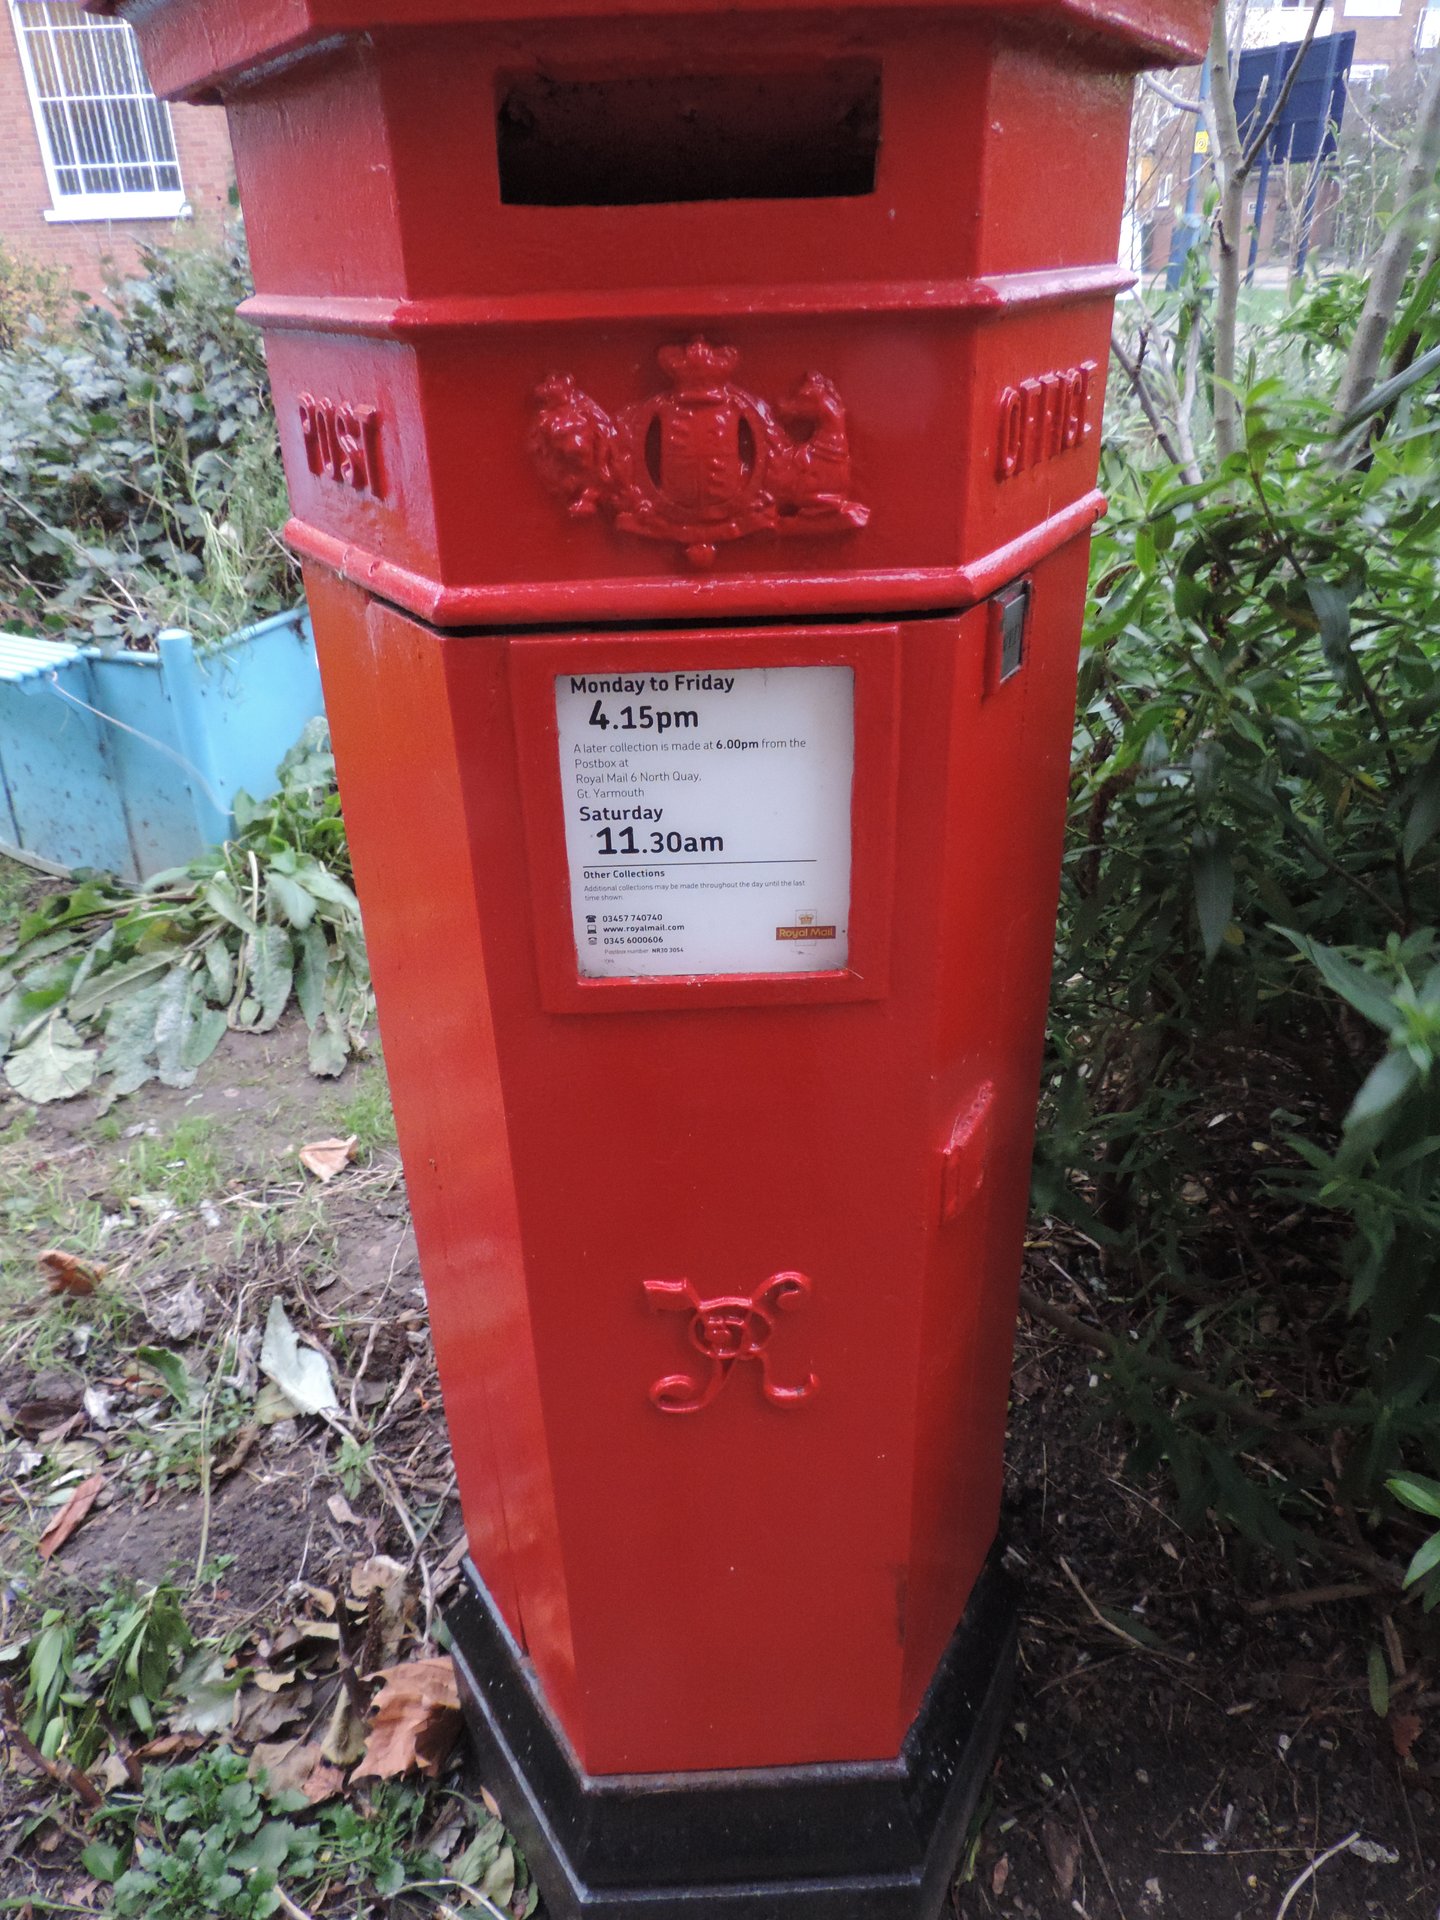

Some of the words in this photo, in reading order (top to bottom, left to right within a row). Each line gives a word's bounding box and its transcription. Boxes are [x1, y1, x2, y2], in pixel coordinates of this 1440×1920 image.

[299, 391, 388, 501] POST
[570, 676, 645, 696] Monday
[650, 676, 669, 692] to
[675, 674, 735, 693] Friday
[588, 700, 699, 733] 4.15pm
[573, 743, 582, 754] A
[583, 743, 607, 754] later
[609, 742, 659, 753] collection
[661, 742, 669, 752] is
[671, 740, 701, 752] made
[703, 740, 714, 751] at
[716, 739, 759, 751] 6.00pm
[761, 738, 787, 749] from
[789, 738, 807, 749] the
[574, 758, 617, 769] Postbox
[619, 758, 629, 768] at
[576, 773, 605, 786] Royal
[606, 772, 628, 784] Mail
[630, 772, 638, 783] 6
[640, 771, 670, 783] North
[592, 787, 645, 799] Yarmouth
[579, 805, 664, 823] Saturday
[596, 826, 724, 855] 11.30am
[583, 869, 611, 879] Other
[613, 868, 666, 879] Collections
[583, 884, 618, 893] Additional
[618, 883, 654, 892] collections
[654, 884, 670, 892] may
[670, 882, 679, 890] be
[679, 882, 699, 890] made
[699, 881, 739, 890] throughout
[739, 880, 750, 888] the
[751, 880, 764, 888] day
[764, 879, 780, 887] until
[780, 879, 792, 887] the
[792, 878, 806, 887] last
[584, 894, 600, 902] time
[602, 914, 629, 923] 03457
[630, 913, 663, 922] 740740
[602, 923, 685, 934] www.royalmail.com
[778, 927, 808, 939] Royal
[810, 927, 833, 937] Mail
[603, 937, 625, 946] 0345
[626, 935, 664, 945] 6000606
